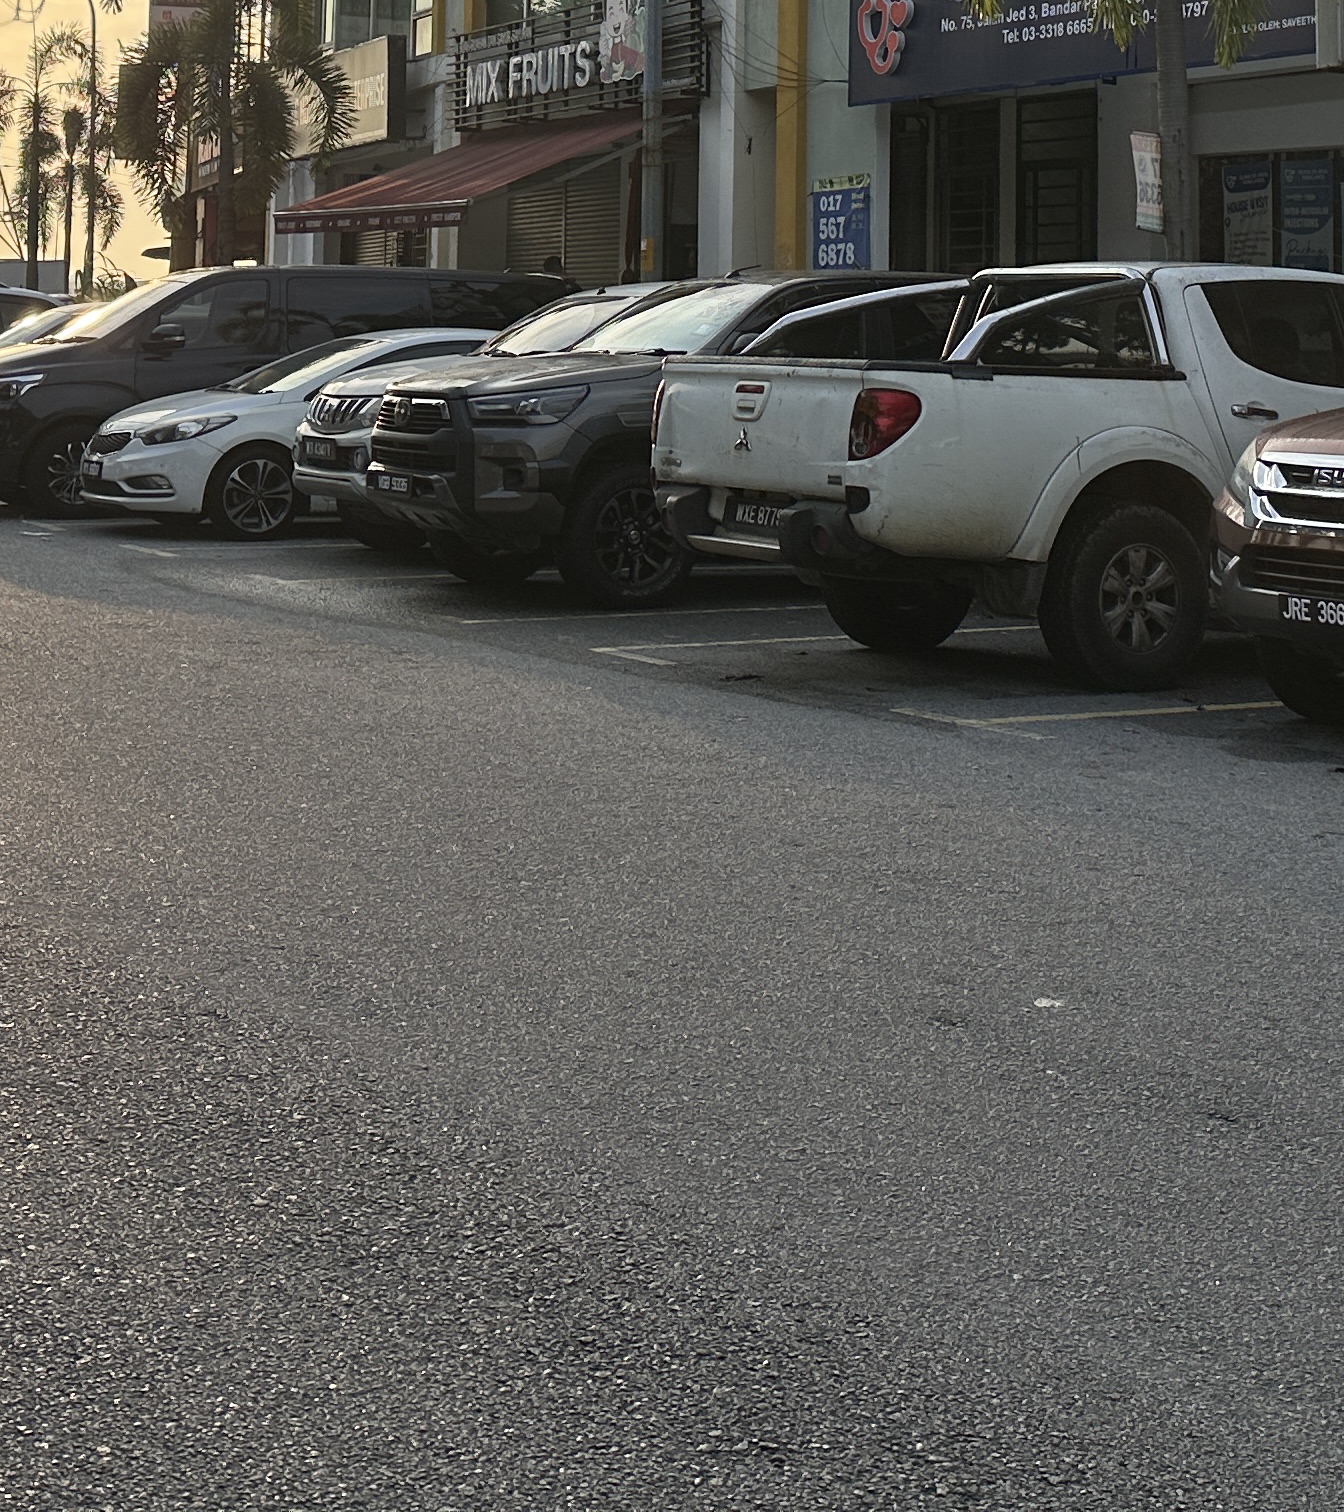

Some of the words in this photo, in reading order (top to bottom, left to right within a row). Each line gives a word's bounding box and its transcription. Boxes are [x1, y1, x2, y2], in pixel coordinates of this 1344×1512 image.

[940, 18, 958, 33] No.
[960, 15, 975, 30] 75,
[1006, 6, 1027, 23] Jed
[1028, 4, 1040, 21] 3,
[1022, 21, 1064, 42] 03-3318
[1066, 17, 1094, 36] 6665
[466, 59, 502, 108] MIX
[820, 194, 843, 212] 017
[818, 216, 846, 240] 567
[818, 242, 855, 267] 6878
[1282, 597, 1312, 622] JRE
